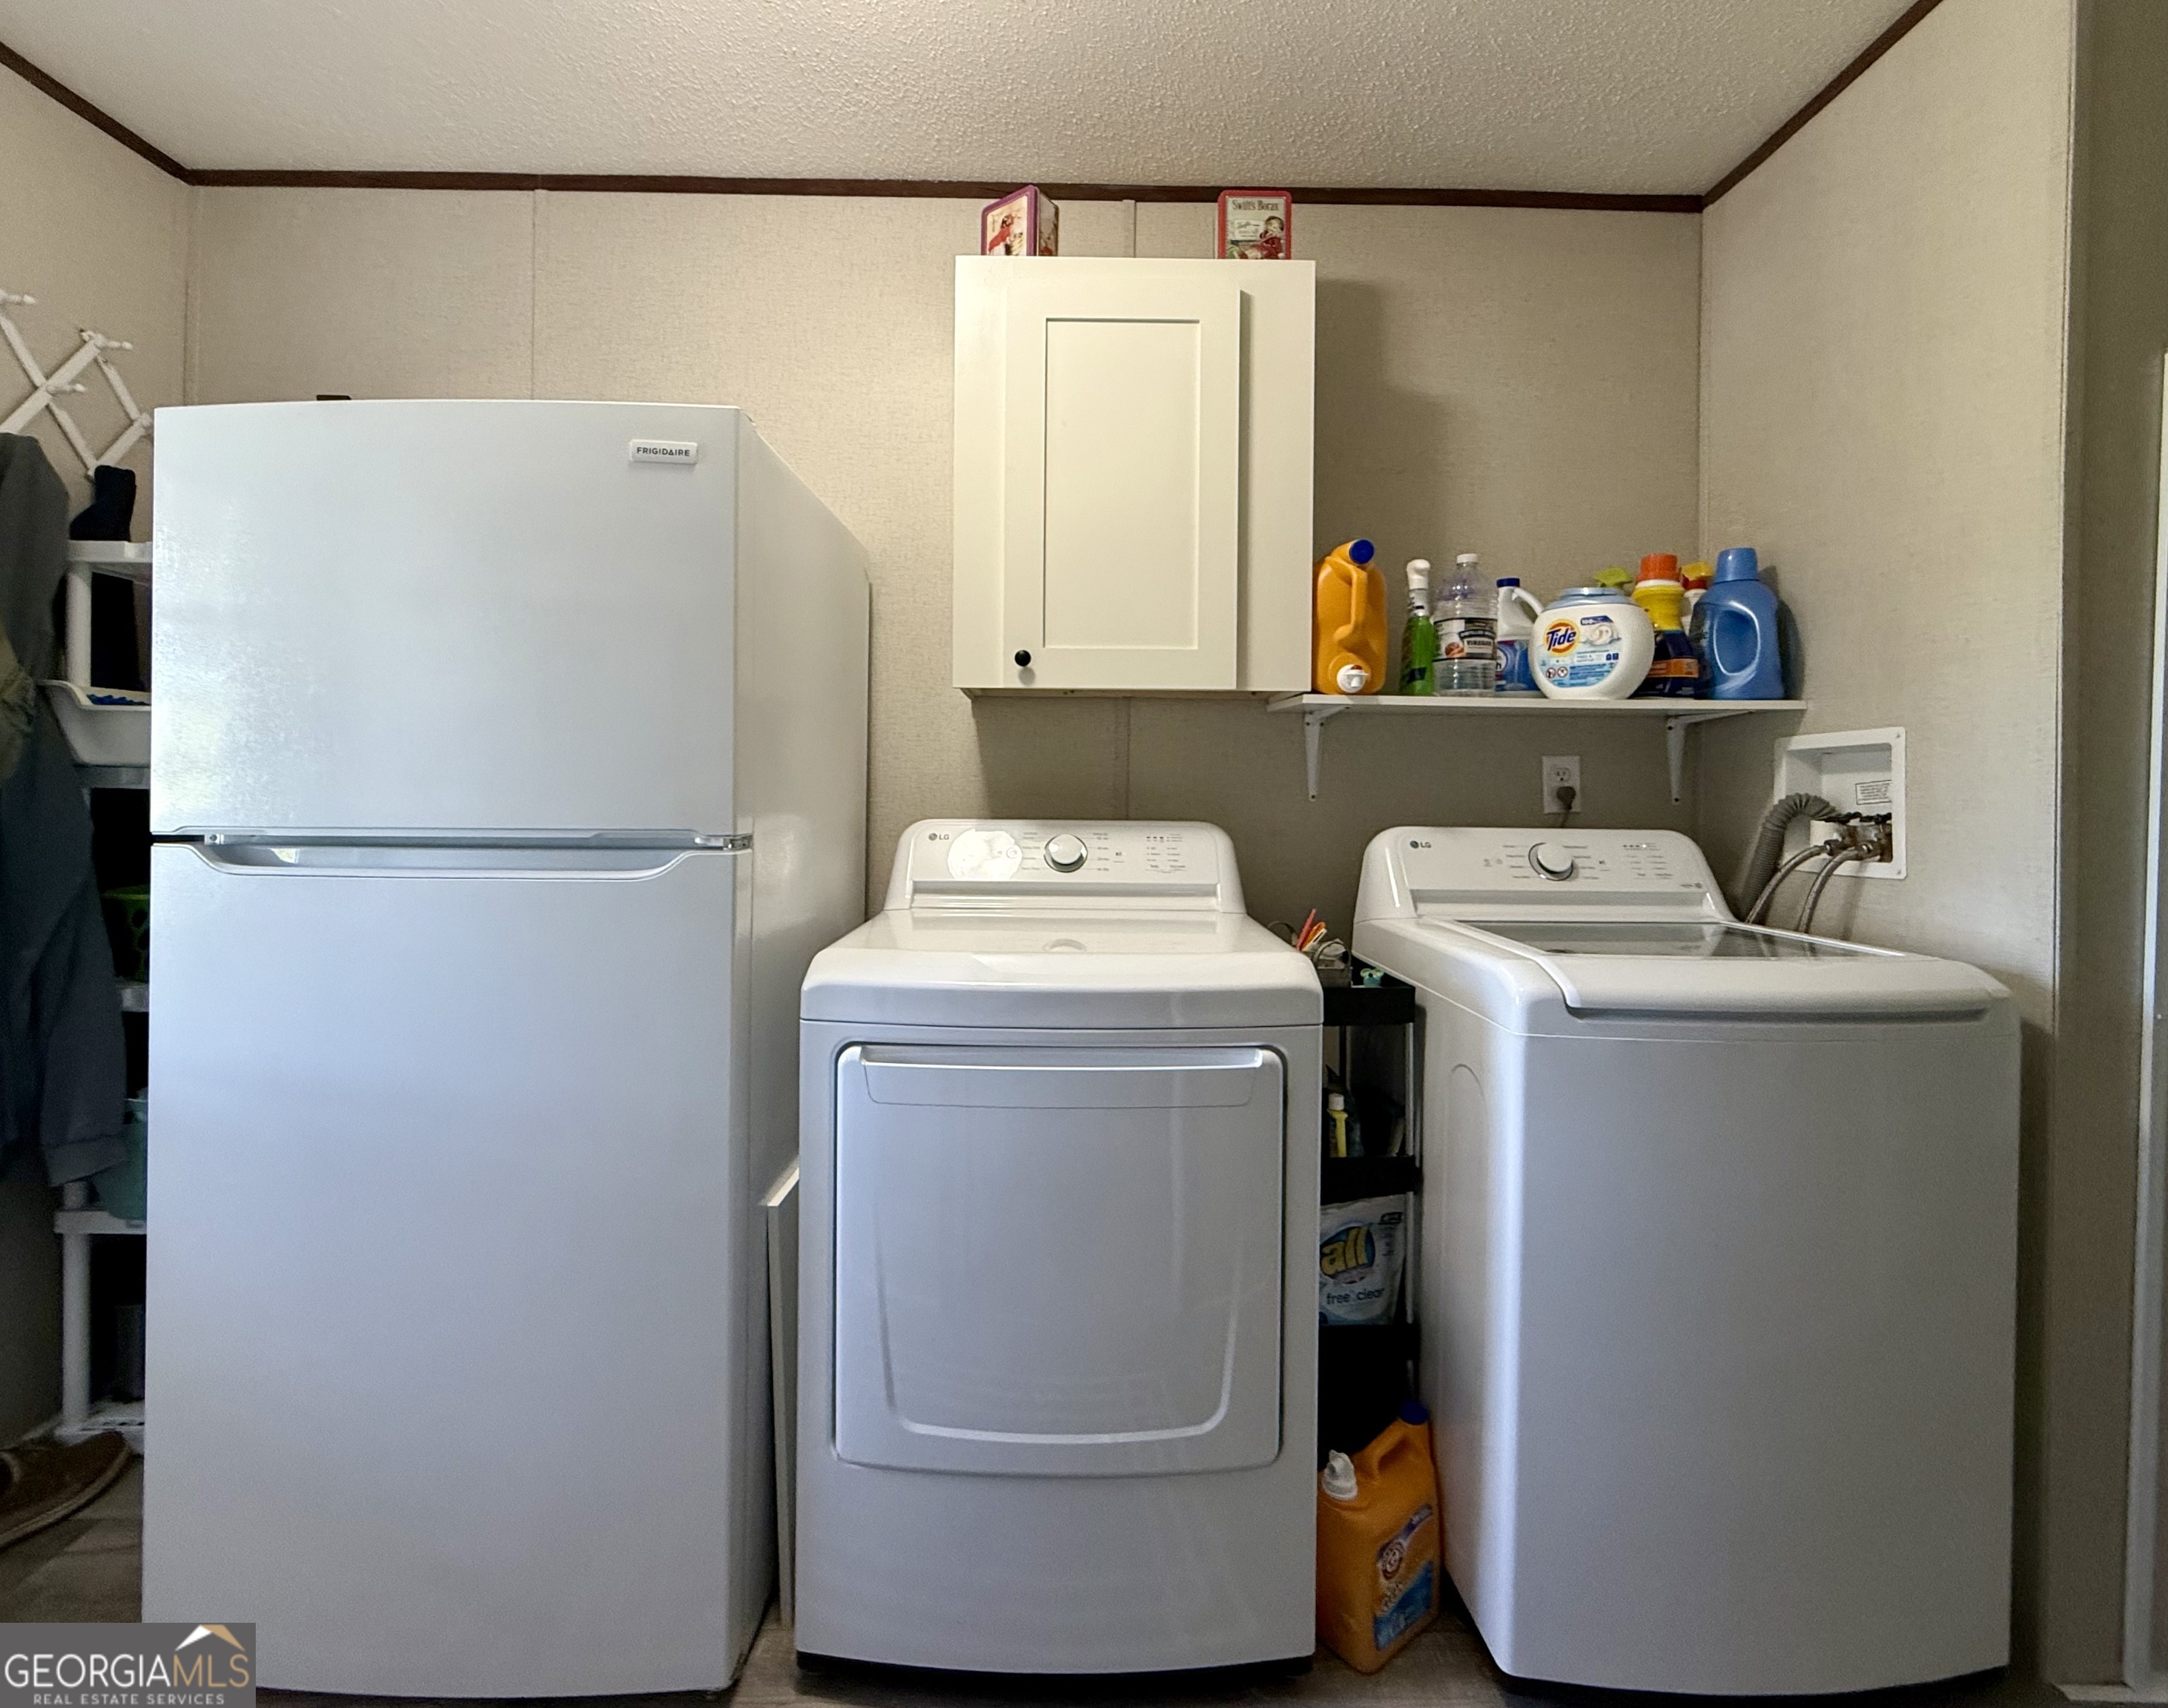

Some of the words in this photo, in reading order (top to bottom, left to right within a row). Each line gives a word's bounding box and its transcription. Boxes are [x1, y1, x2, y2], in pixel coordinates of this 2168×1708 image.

[636, 446, 691, 457] FRIGIDAIRE
[1546, 626, 1577, 652] Tide
[1320, 1227, 1368, 1277] all
[1326, 1292, 1350, 1305] free
[1357, 1288, 1385, 1302] clear
